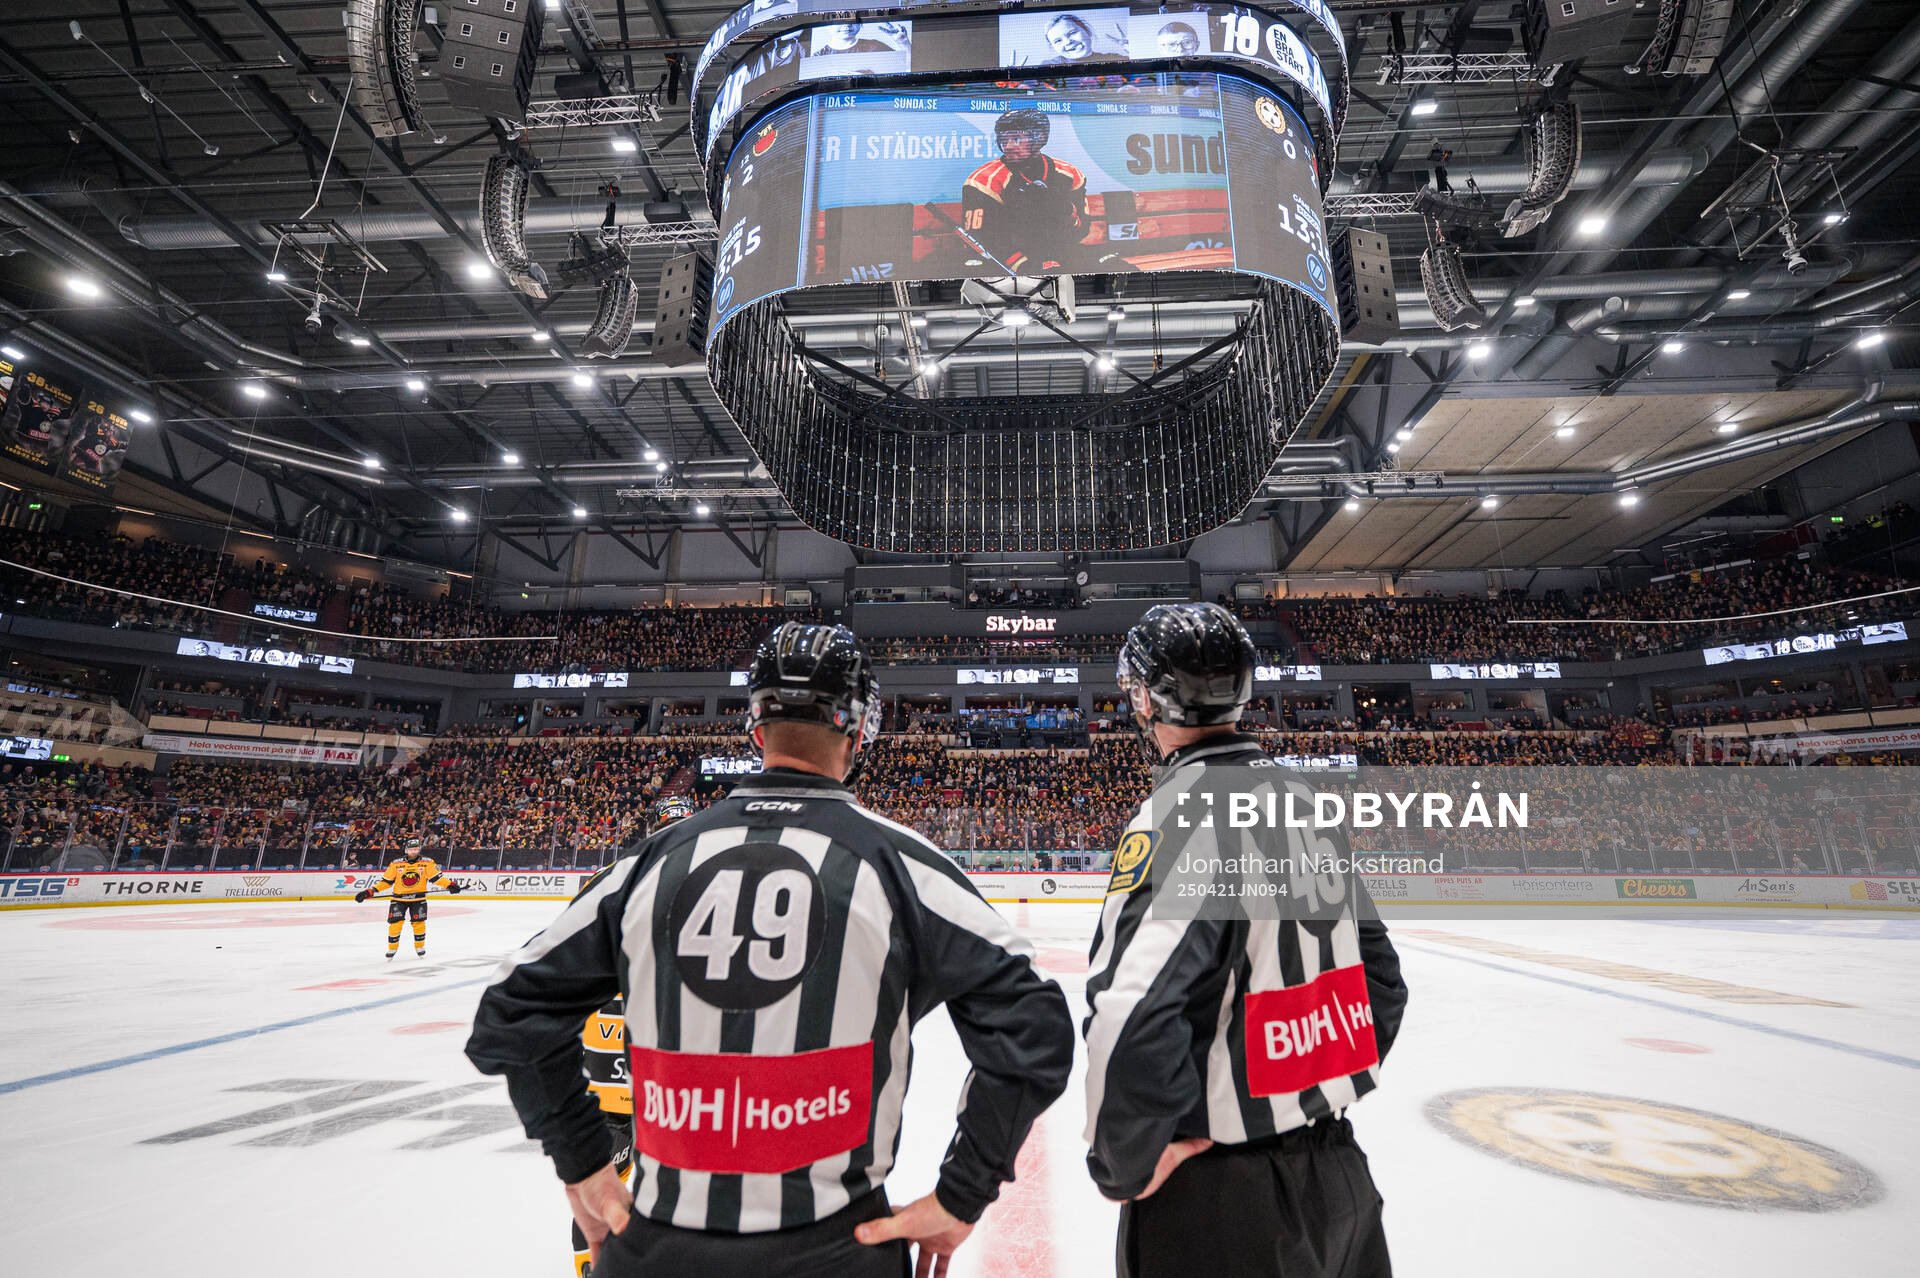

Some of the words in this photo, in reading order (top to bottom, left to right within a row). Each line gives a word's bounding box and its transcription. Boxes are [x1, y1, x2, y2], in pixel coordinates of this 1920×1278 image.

[1220, 12, 1260, 56] 10
[1273, 28, 1287, 43] EN
[1274, 39, 1295, 60] BRA
[1276, 50, 1305, 76] START
[825, 95, 857, 109] DA.SE
[893, 97, 938, 110] SUNDA.SE
[1036, 101, 1072, 113] SUNDA.SE
[1096, 103, 1128, 115] SUNDA.SE
[822, 134, 842, 163] R
[849, 134, 858, 161] I
[742, 163, 754, 187] 2
[985, 615, 1057, 634] Skybar
[1867, 735, 1890, 744] mat
[1892, 732, 1909, 743] på
[252, 745, 270, 754] mat
[271, 745, 285, 755] på
[744, 801, 802, 813] CCM
[1286, 816, 1346, 915] 45
[0, 877, 68, 898] TSG
[103, 880, 204, 895] THORNE
[514, 875, 566, 887] CCVE
[1623, 879, 1687, 897] Cheers
[1738, 878, 1796, 893] AnSan's
[225, 887, 283, 897] TRELLEBORG
[676, 868, 813, 981] 49
[1264, 1004, 1339, 1061] BWH
[643, 1079, 725, 1132] BWH
[745, 1085, 851, 1131] Hotels
